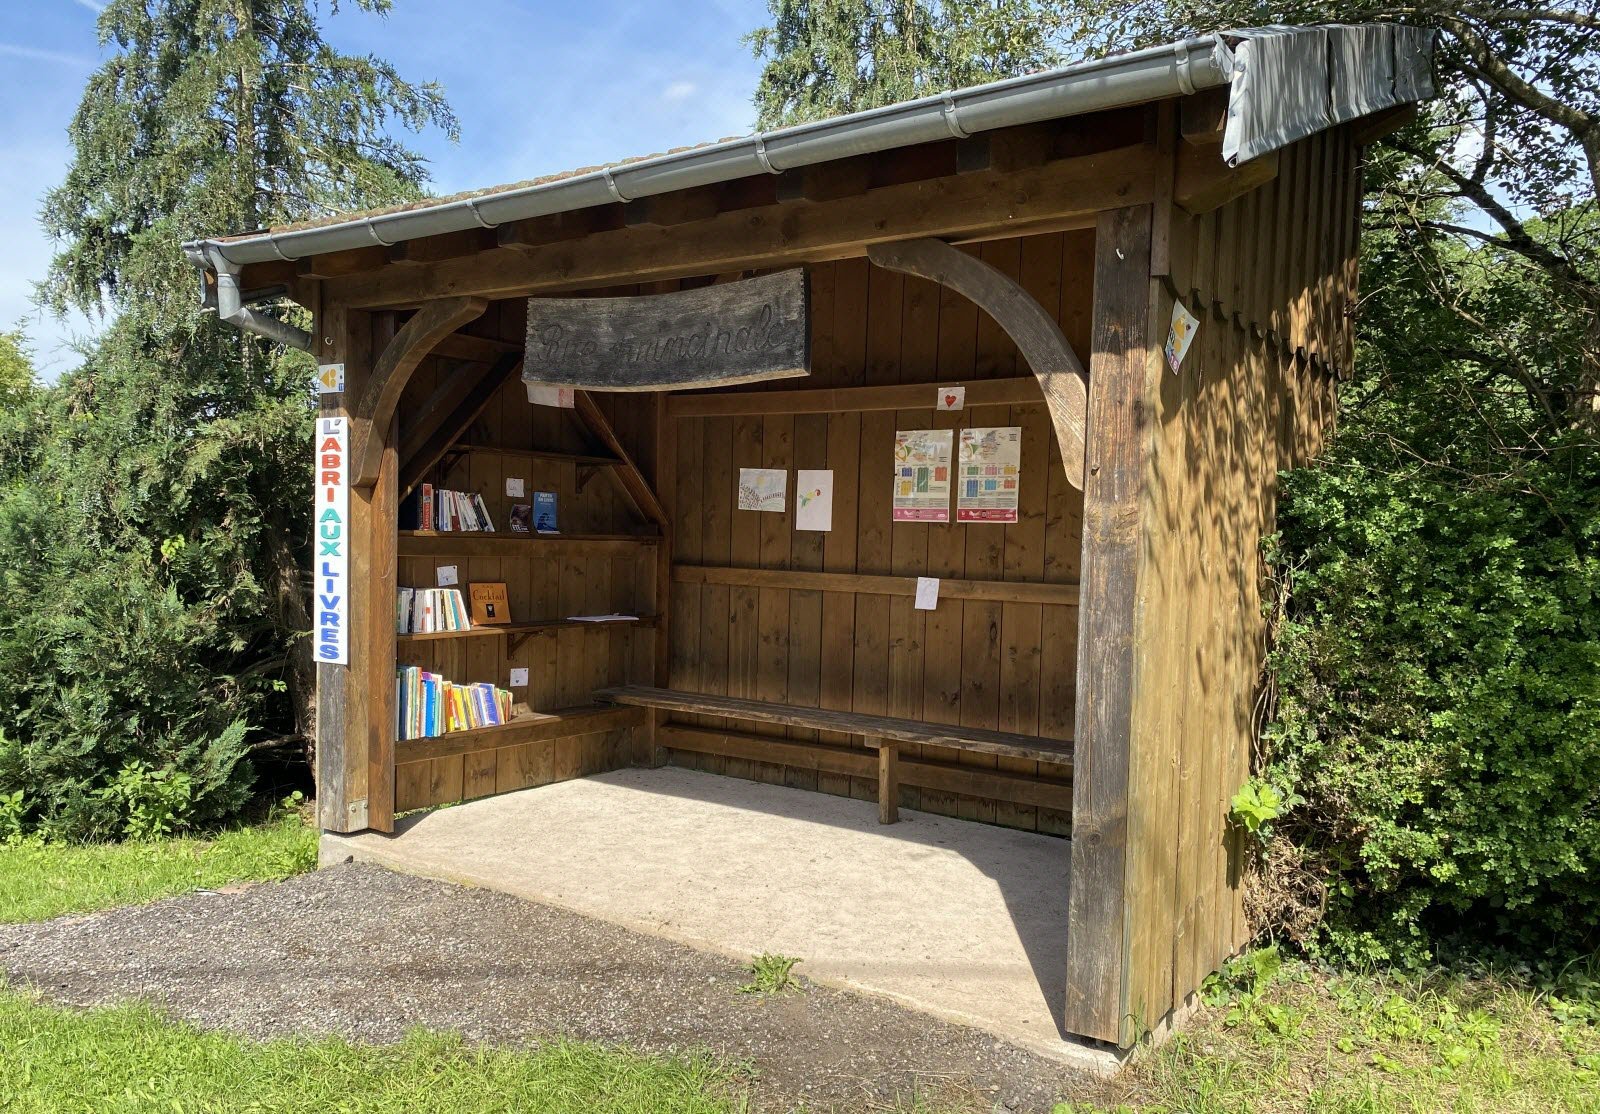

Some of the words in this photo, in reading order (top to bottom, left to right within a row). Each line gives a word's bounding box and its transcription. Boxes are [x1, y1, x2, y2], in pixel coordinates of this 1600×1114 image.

[319, 418, 342, 503] L'ABRI
[319, 507, 342, 557] AUX
[318, 561, 342, 660] LIVRES
